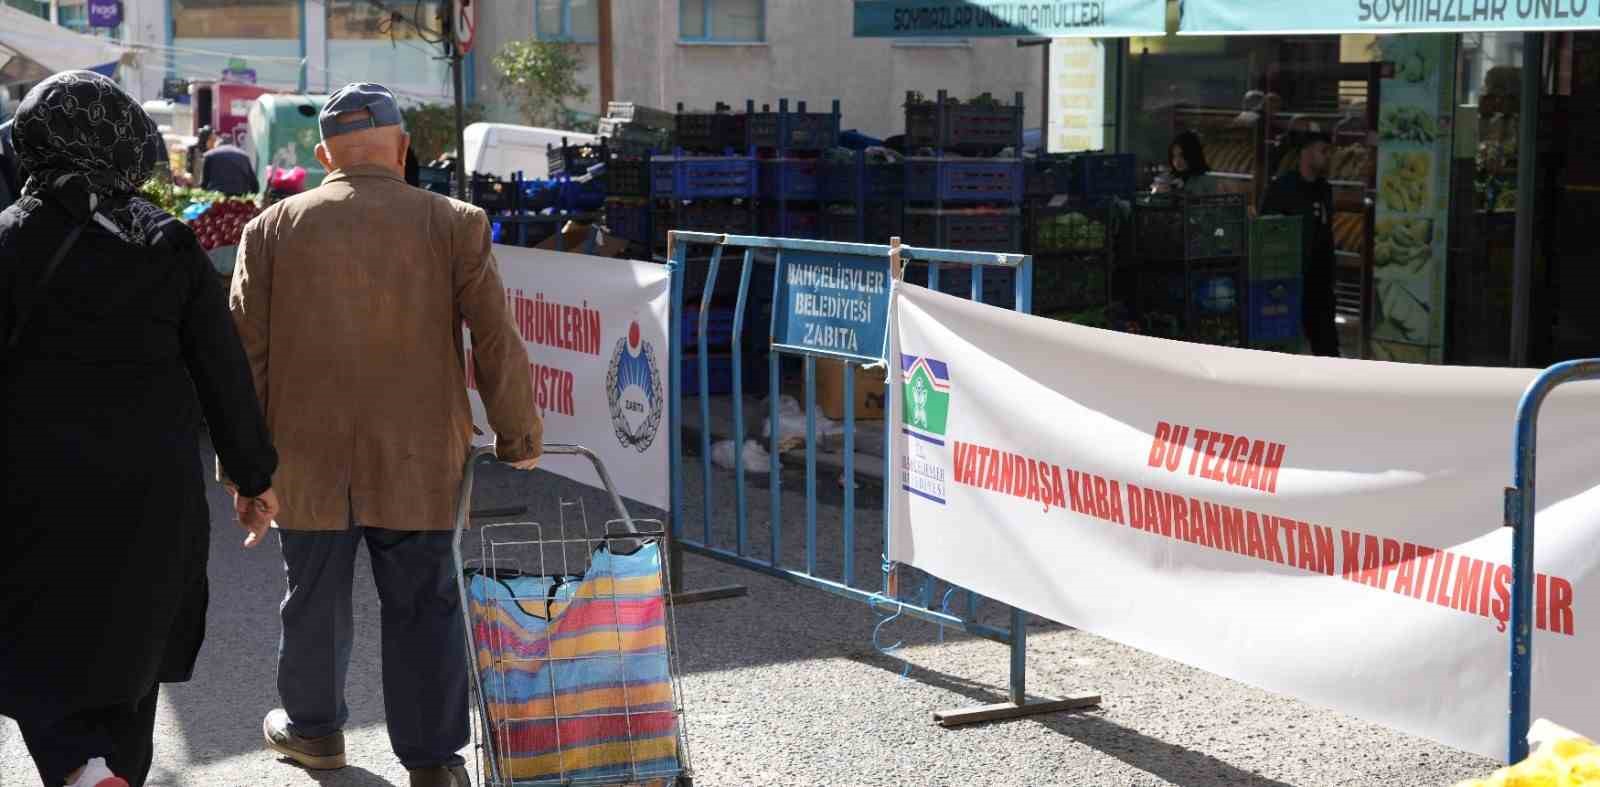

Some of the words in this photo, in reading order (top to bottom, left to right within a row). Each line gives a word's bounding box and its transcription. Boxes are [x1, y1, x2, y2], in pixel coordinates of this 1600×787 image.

[894, 7, 975, 31] SOYMAZLAR
[786, 262, 884, 294] BAHÇELİEVLER
[515, 288, 600, 356] ÜRÜNLERİN
[794, 292, 872, 323] BELEDİYESİ
[803, 322, 858, 351] ZABITA
[529, 363, 575, 417] IŞTIR
[1148, 421, 1189, 472] BU
[1188, 428, 1285, 494] TEZGAH
[953, 441, 1066, 513] VATANDAŞA
[1067, 467, 1125, 525] KABA
[1127, 484, 1335, 577] DAVRANMAKTAN
[1341, 529, 1574, 636] KAPATILMIŞIR
